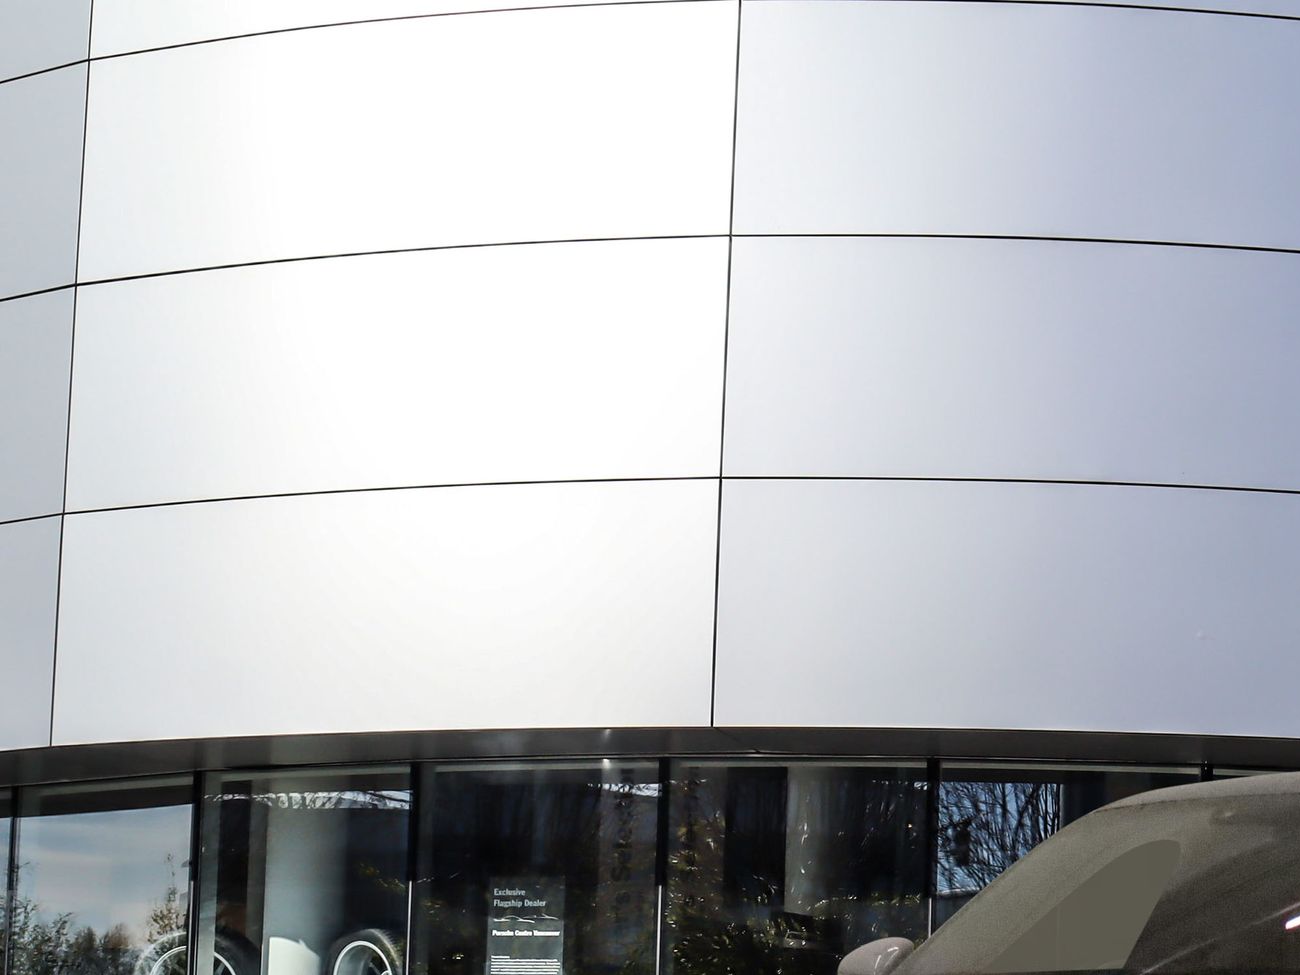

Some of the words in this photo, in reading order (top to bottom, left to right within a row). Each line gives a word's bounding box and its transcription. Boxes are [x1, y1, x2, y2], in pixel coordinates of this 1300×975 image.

[494, 888, 526, 896] Exclusive
[493, 899, 523, 908] Flagship
[524, 899, 546, 907] Dealer
